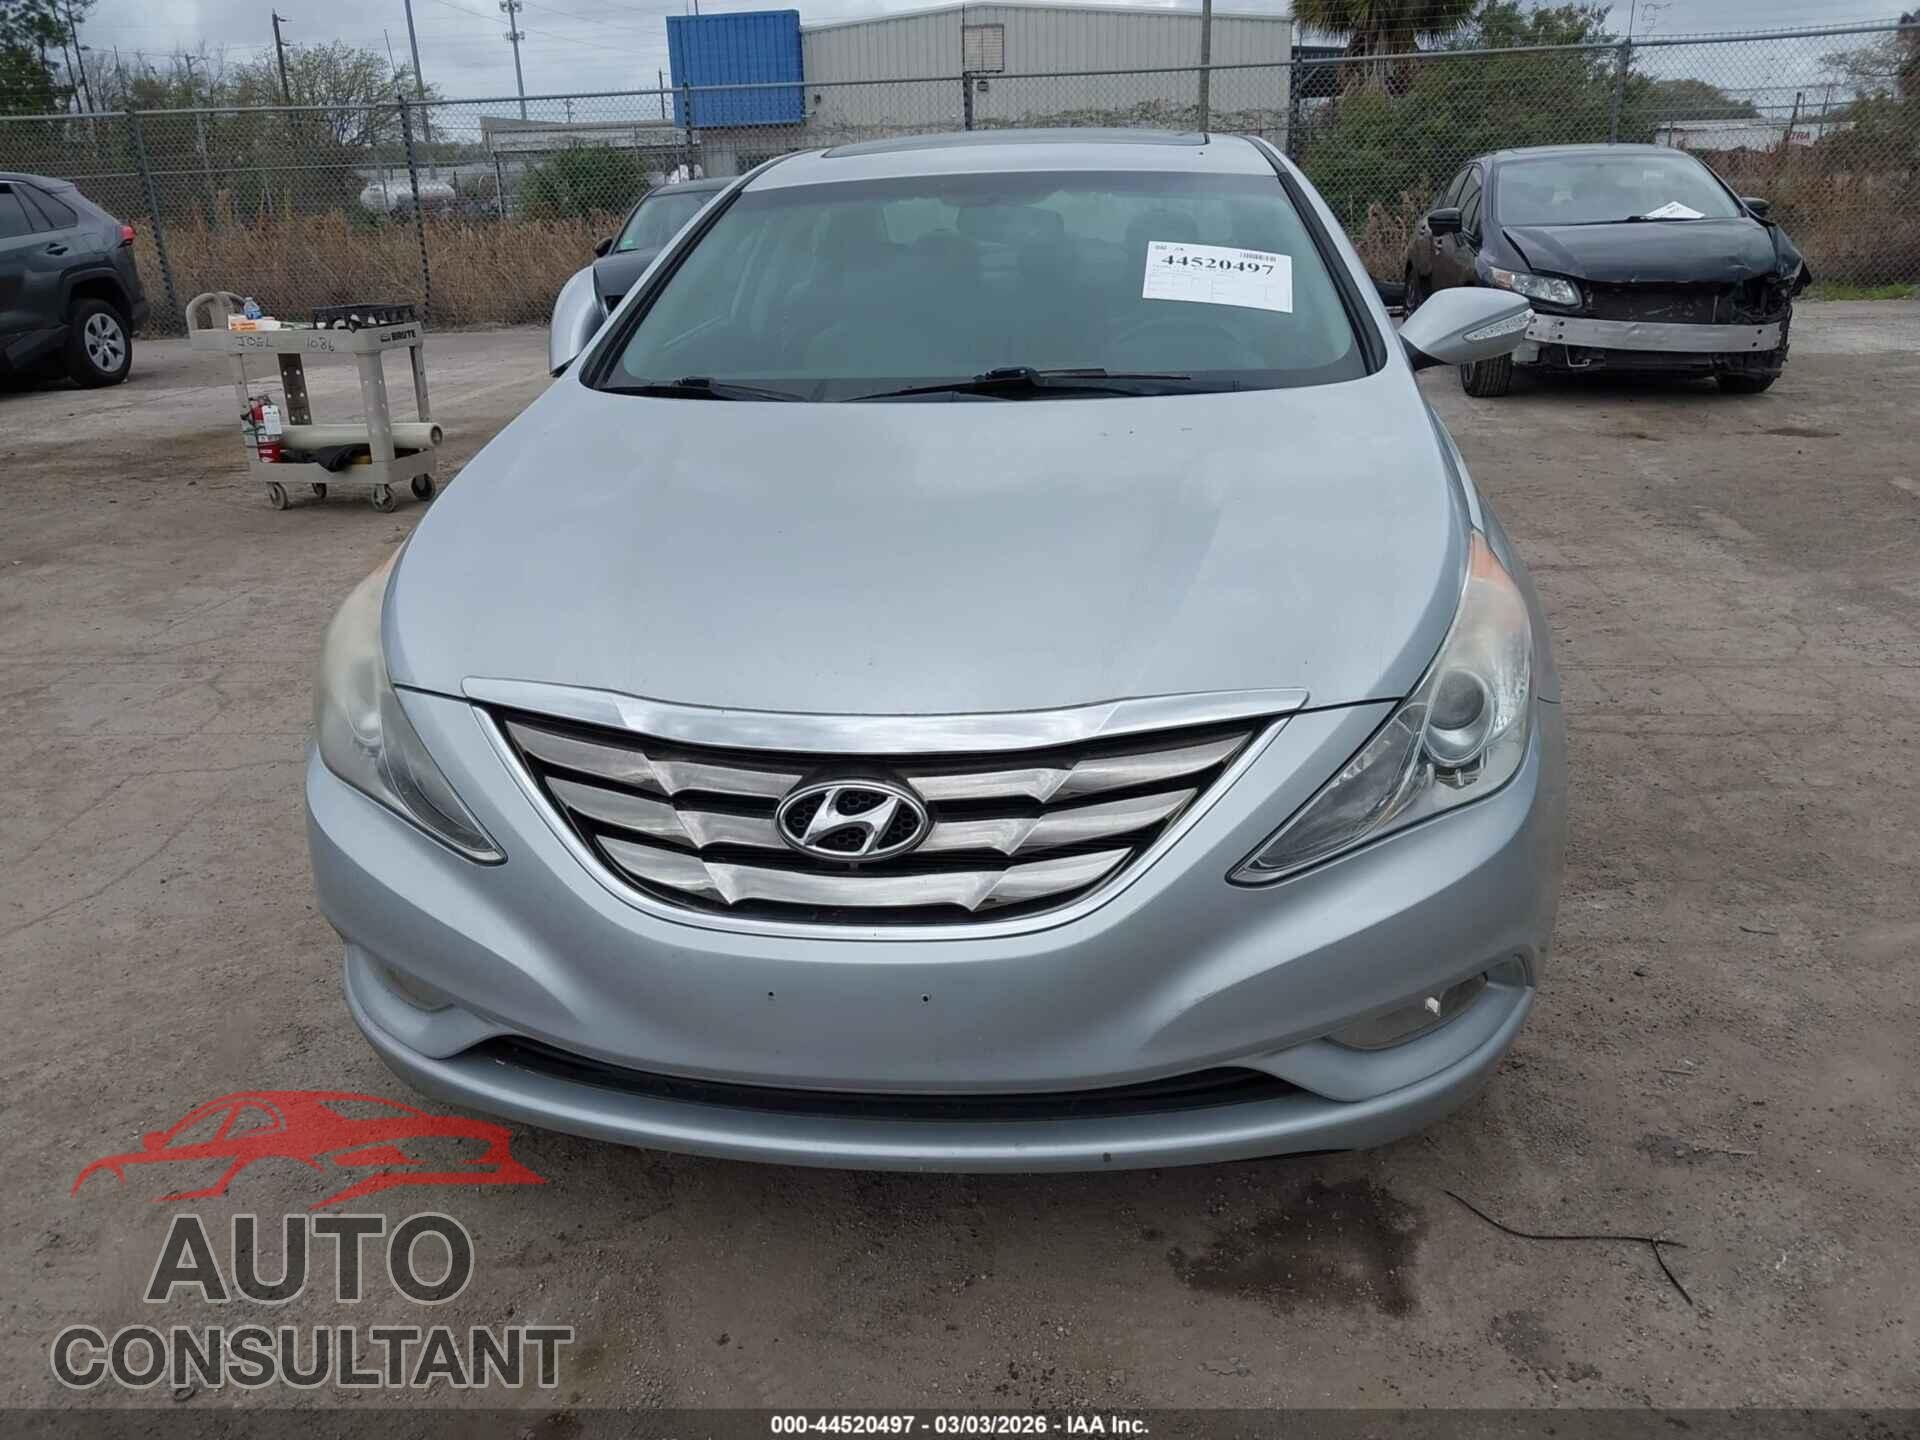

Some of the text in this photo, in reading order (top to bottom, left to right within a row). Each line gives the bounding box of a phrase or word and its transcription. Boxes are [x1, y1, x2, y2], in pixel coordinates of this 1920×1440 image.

[1161, 254, 1275, 276] 44520497
[234, 335, 273, 348] JOEL
[391, 329, 417, 341] BRUTE
